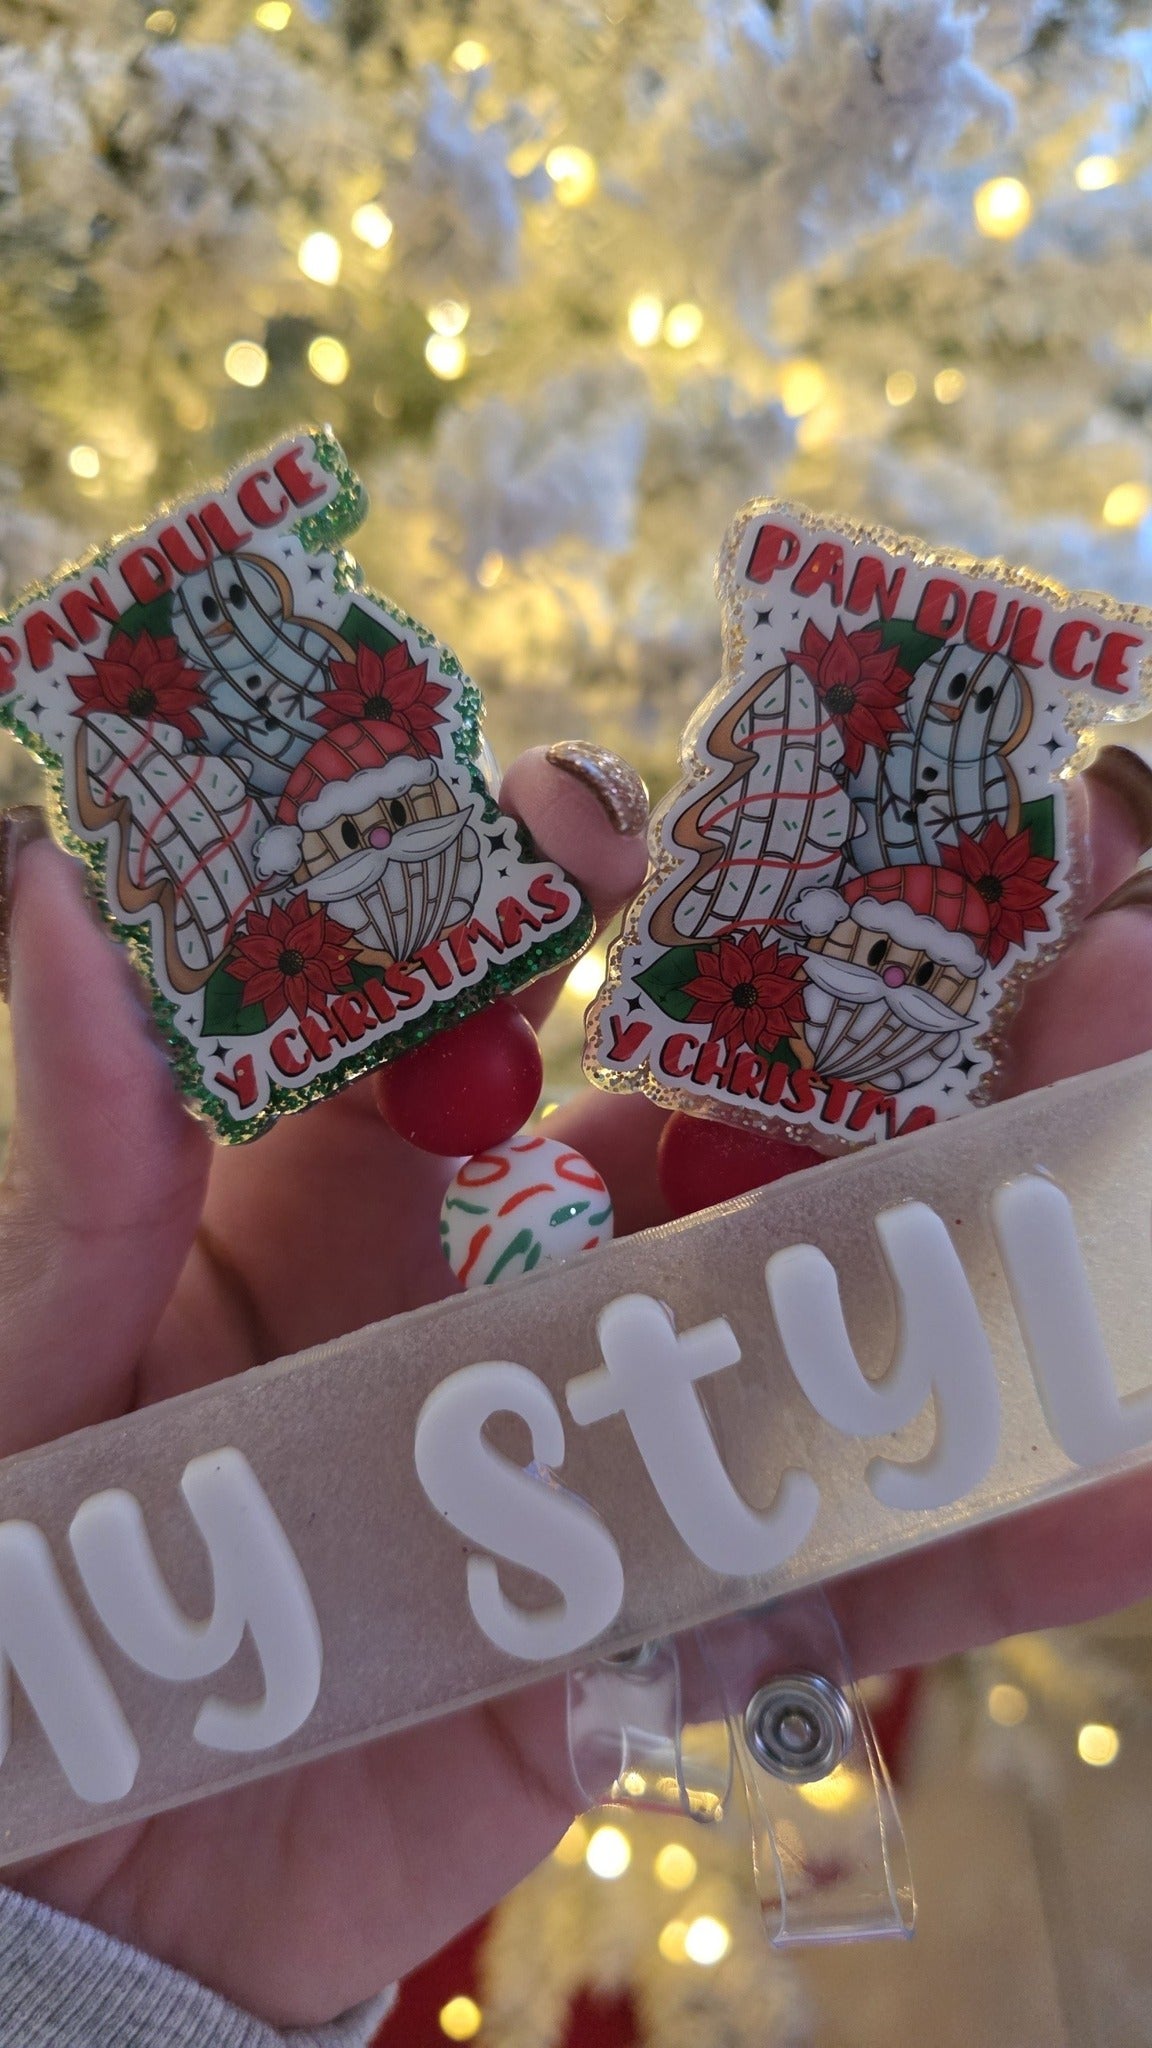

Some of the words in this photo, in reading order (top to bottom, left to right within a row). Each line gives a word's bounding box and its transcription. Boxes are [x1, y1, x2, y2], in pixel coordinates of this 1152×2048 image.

[119, 446, 328, 604] DULCE
[745, 524, 906, 622] PAN
[913, 578, 1143, 695] DULCE
[215, 1054, 259, 1110] Y
[269, 873, 571, 1077] CHRISTMAS
[605, 1014, 652, 1062] Y
[659, 1033, 954, 1140] CHRISTM
